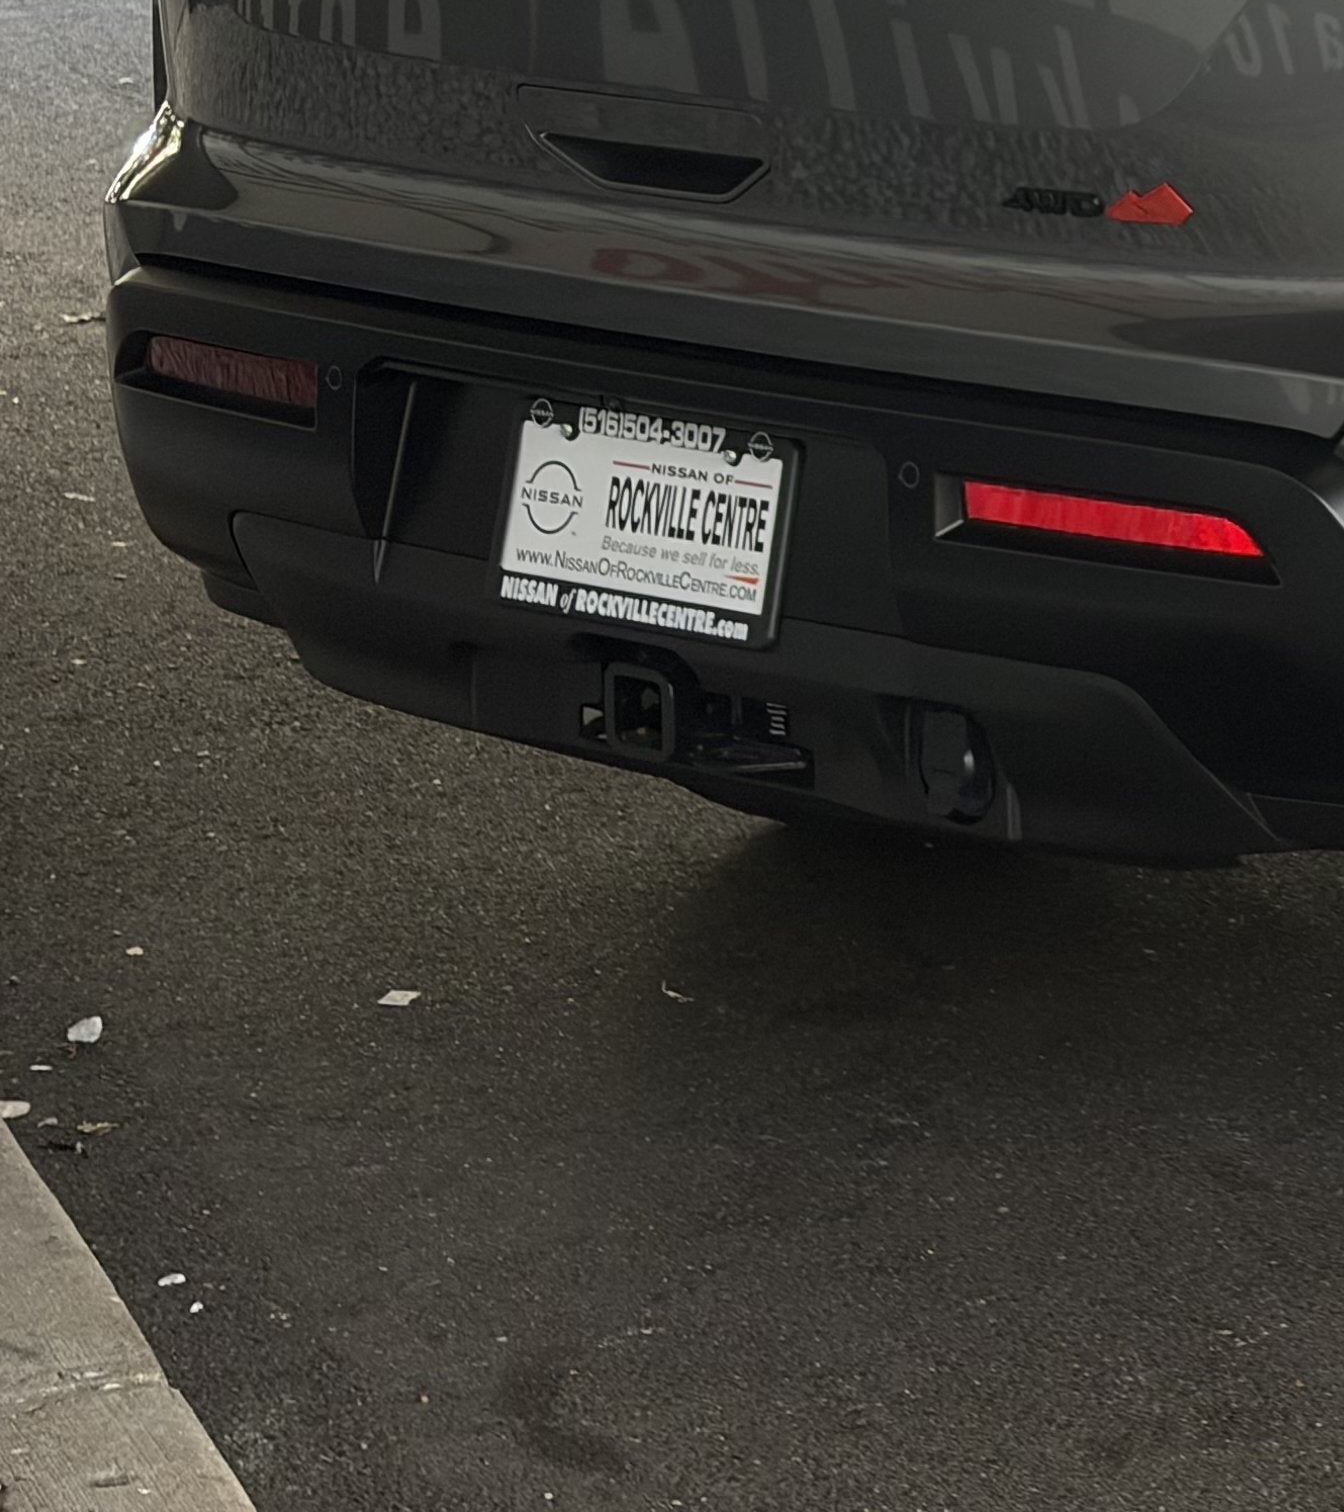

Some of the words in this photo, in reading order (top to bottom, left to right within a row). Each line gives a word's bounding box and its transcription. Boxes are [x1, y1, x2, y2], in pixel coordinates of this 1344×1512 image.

[652, 463, 709, 482] NISSAN
[713, 472, 735, 486] OF
[521, 486, 583, 508] NISSAN
[605, 476, 701, 542] ROCKVILLE
[700, 490, 770, 553] CENTRE
[601, 535, 657, 559] Because
[660, 548, 679, 562] we
[682, 547, 707, 567] sell
[709, 553, 728, 571] for
[501, 576, 559, 607] NISSAN
[560, 591, 576, 614] of
[575, 588, 749, 641] ROCKVILLECENTRE.com
